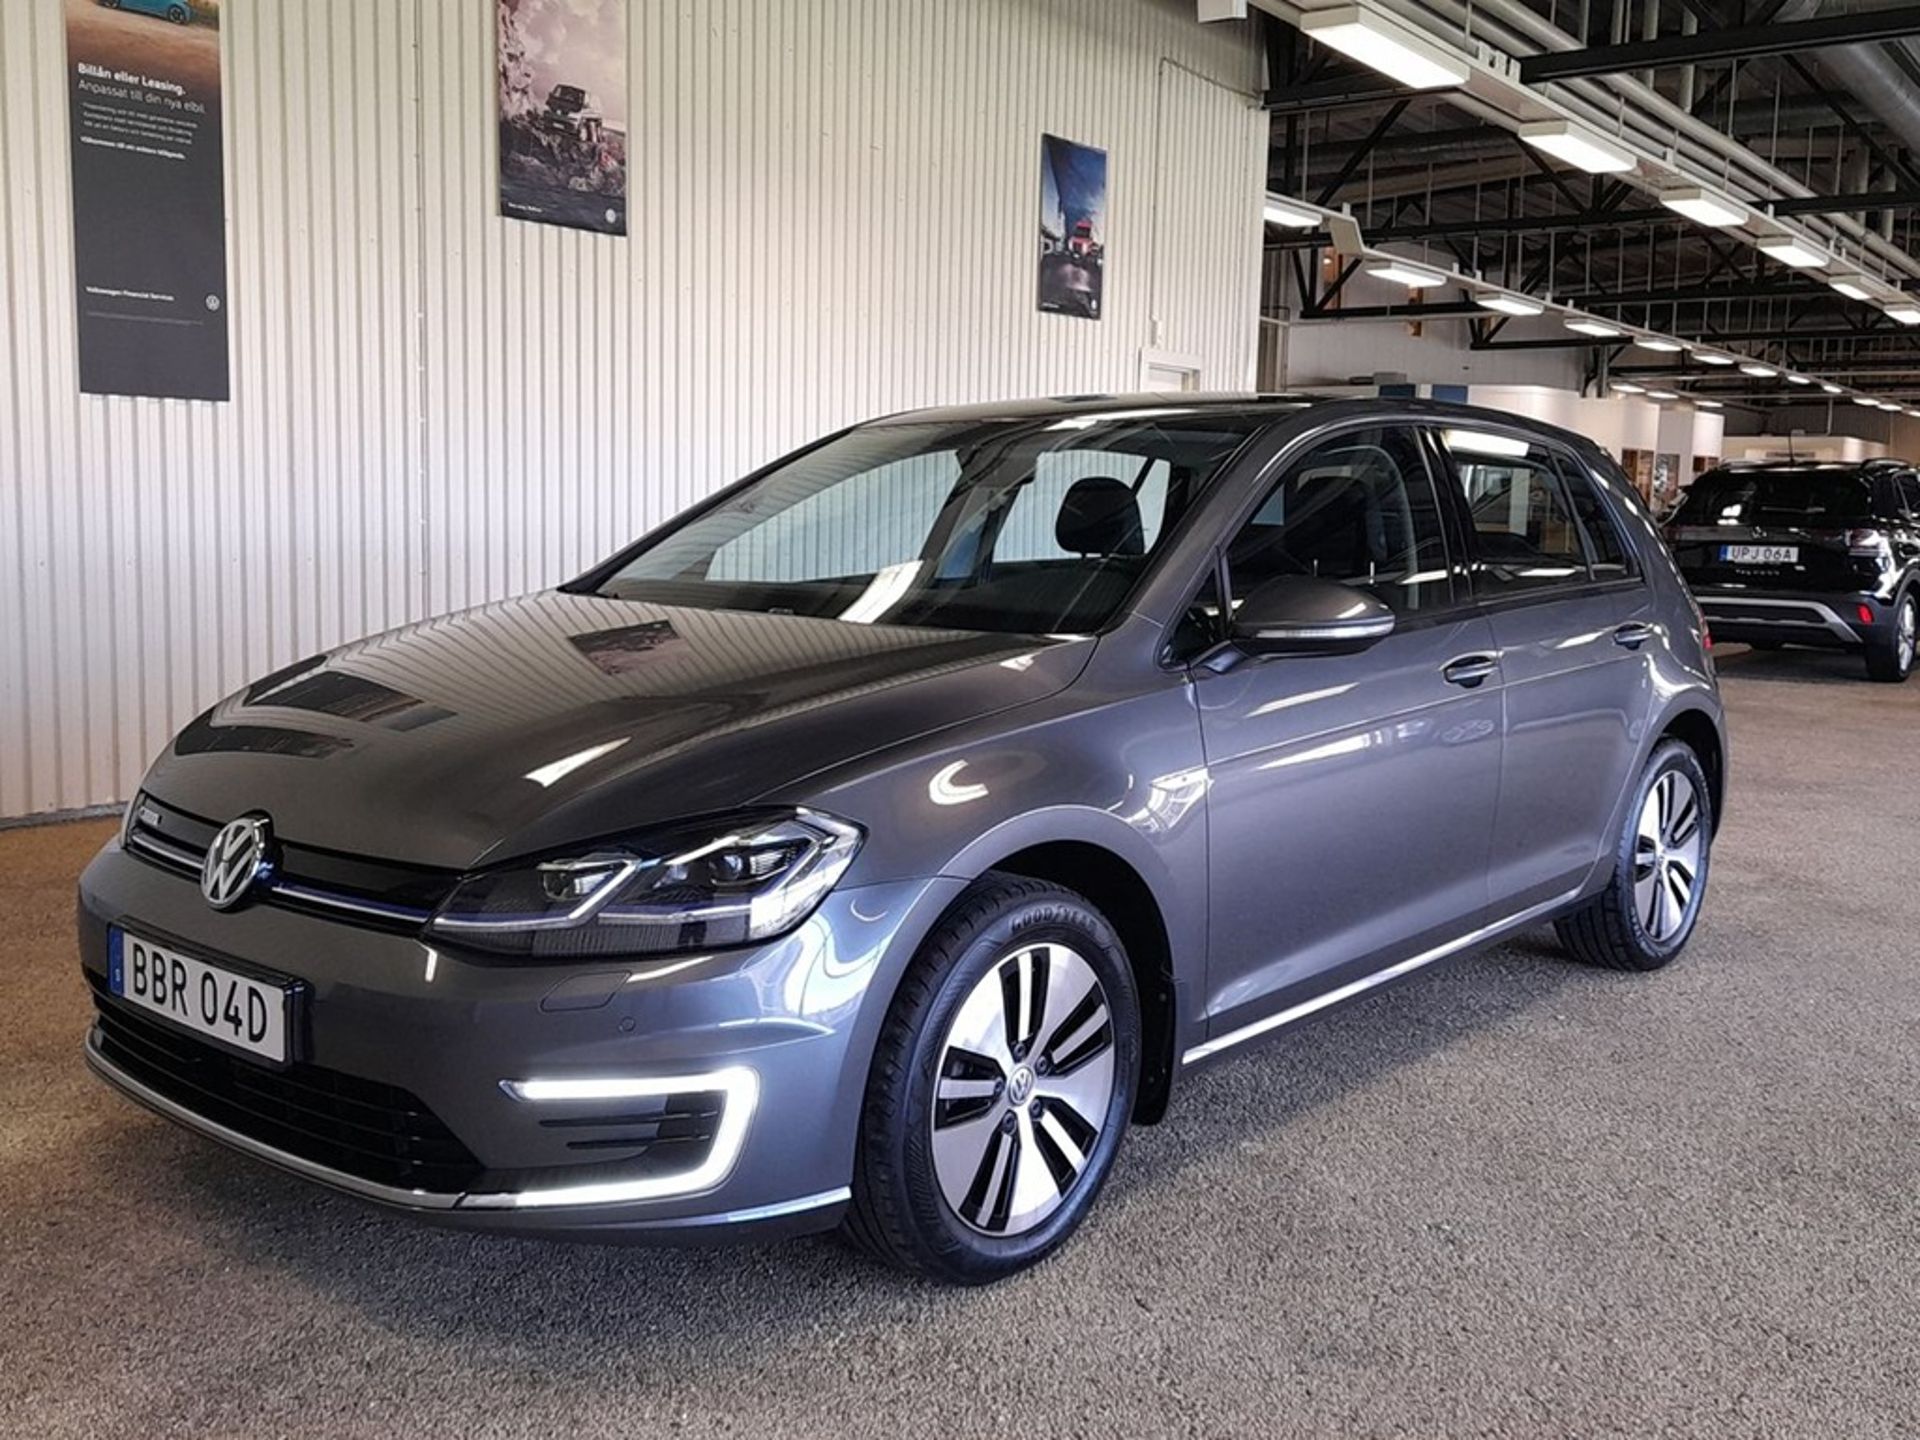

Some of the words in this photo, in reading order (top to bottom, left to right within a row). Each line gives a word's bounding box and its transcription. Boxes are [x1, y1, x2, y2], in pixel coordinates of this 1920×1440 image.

[78, 62, 111, 78] Billån
[114, 72, 139, 85] eller
[142, 76, 186, 96] Leasing.
[78, 80, 128, 98] Anpassat
[130, 90, 143, 101] till
[145, 92, 162, 105] din
[164, 97, 182, 110] nya
[1732, 546, 1760, 560] UPJ
[1763, 547, 1792, 561] 06A
[132, 942, 188, 1017] BBR
[201, 970, 267, 1043] 04D
